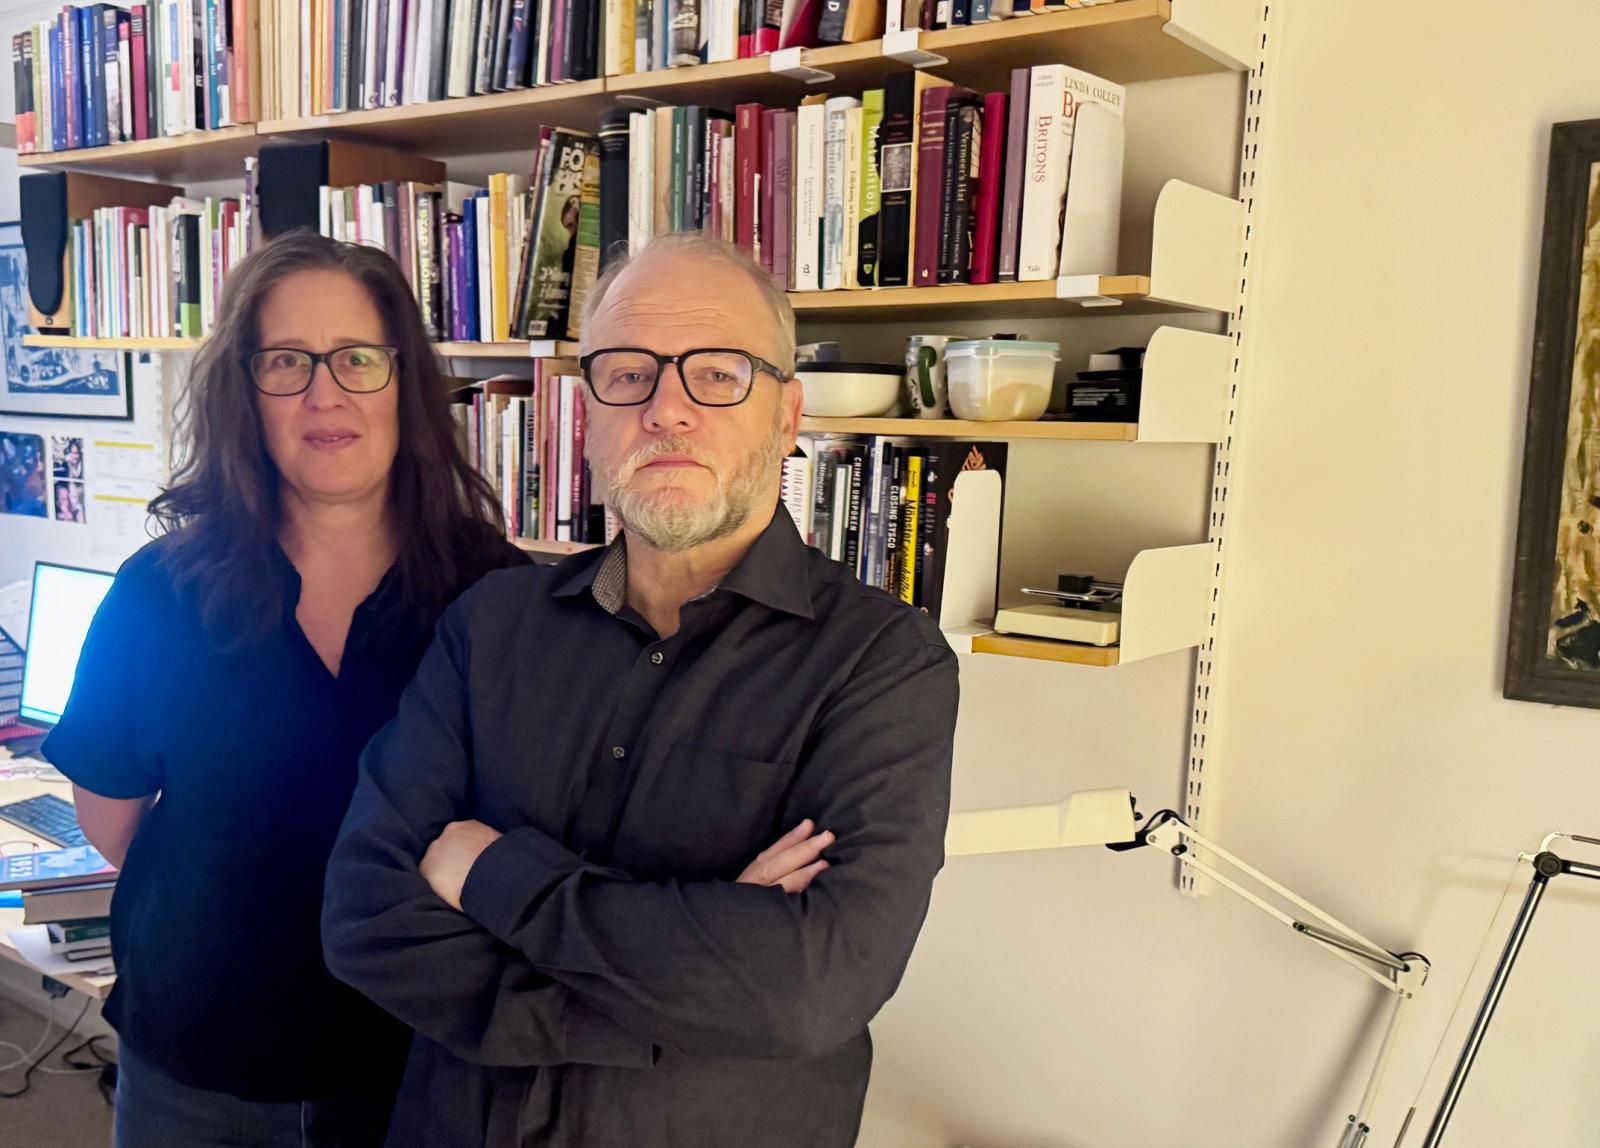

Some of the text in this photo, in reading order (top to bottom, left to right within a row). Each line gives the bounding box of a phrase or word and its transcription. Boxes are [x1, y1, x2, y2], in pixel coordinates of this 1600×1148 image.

[1064, 76, 1089, 96] LINDA
[1092, 87, 1121, 107] COLLEY
[959, 131, 970, 181] Vermeer's
[1035, 116, 1053, 183] BRITONS
[864, 125, 880, 213] Metahistory
[957, 183, 967, 202] Hat
[1027, 265, 1041, 273] Yale
[852, 457, 862, 487] CRIMES
[792, 468, 804, 514] THEATRES
[889, 485, 899, 520] CLOSING
[849, 489, 860, 532] UNSPOKEN
[887, 522, 898, 549] SYSCO
